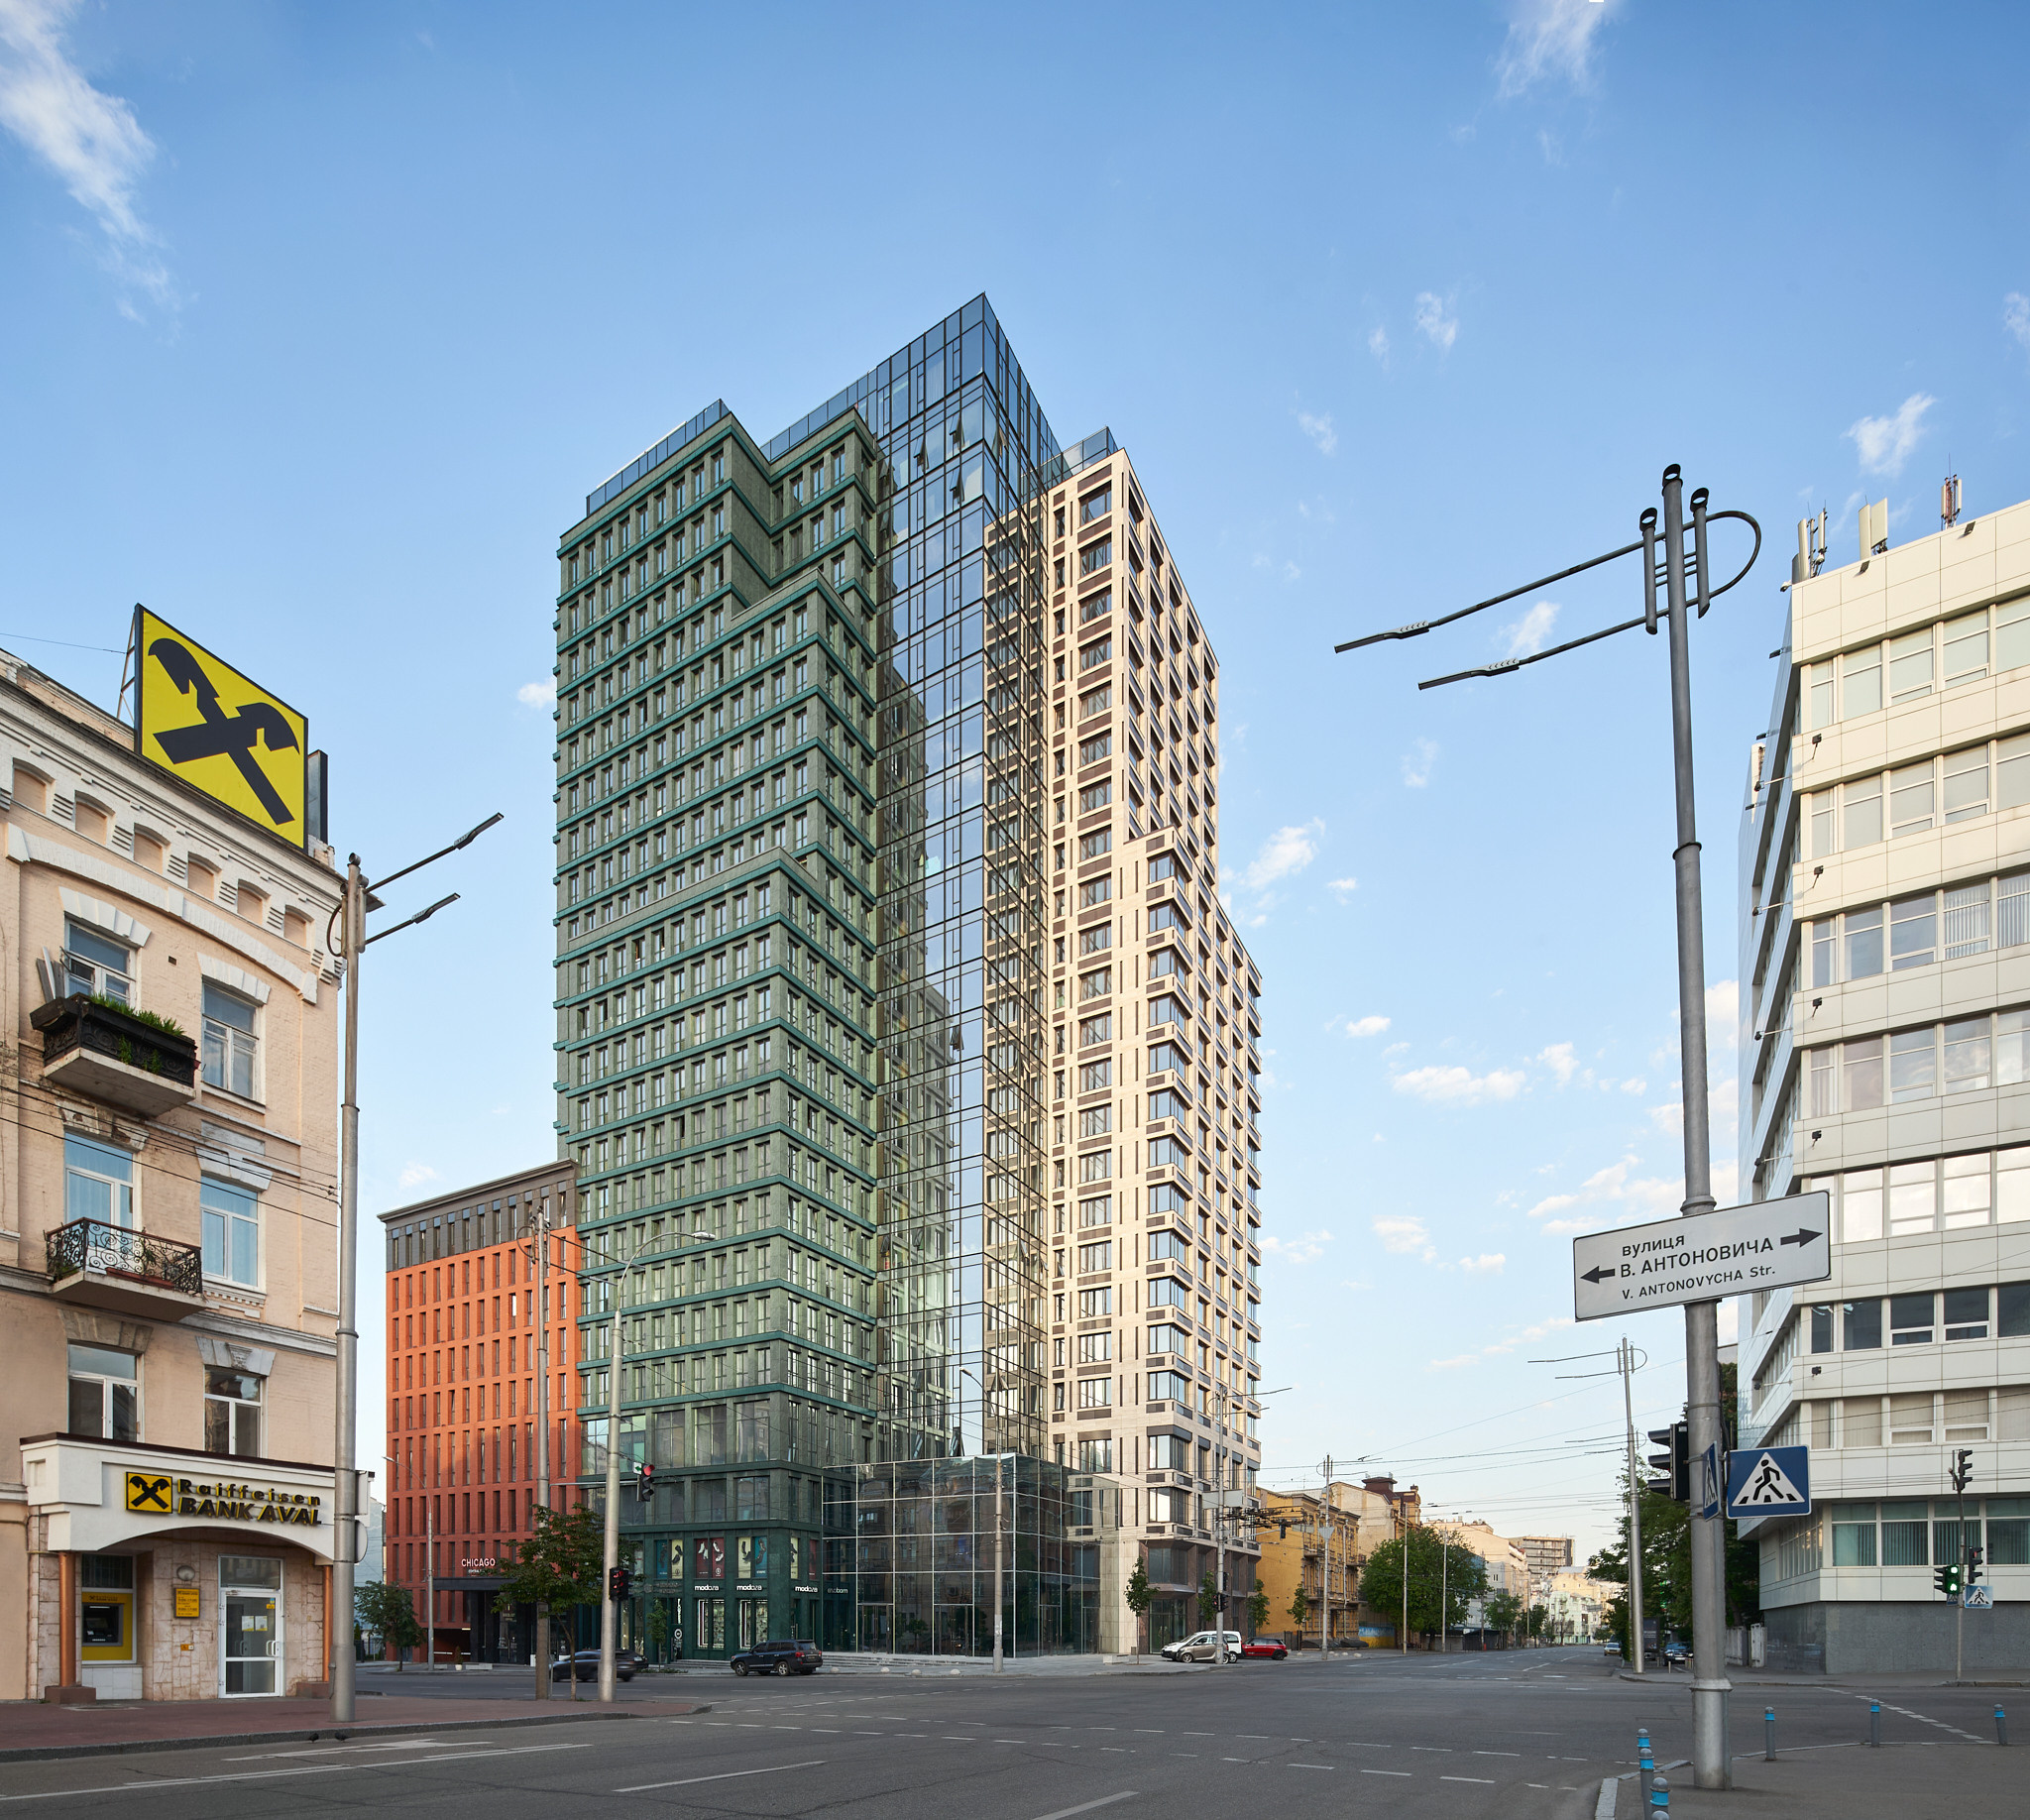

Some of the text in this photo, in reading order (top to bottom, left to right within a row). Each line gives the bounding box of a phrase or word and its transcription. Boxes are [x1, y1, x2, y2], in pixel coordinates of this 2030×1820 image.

[1620, 1237, 1774, 1278] В. АНТОНОВИЧА
[1622, 1235, 1685, 1259] вулиця
[1622, 1265, 1775, 1300] V. ANTONOVYCHA Str.
[177, 1478, 321, 1506] Raiffeisen
[177, 1496, 322, 1525] BANK AVAL
[461, 1557, 496, 1567] CHICAGO
